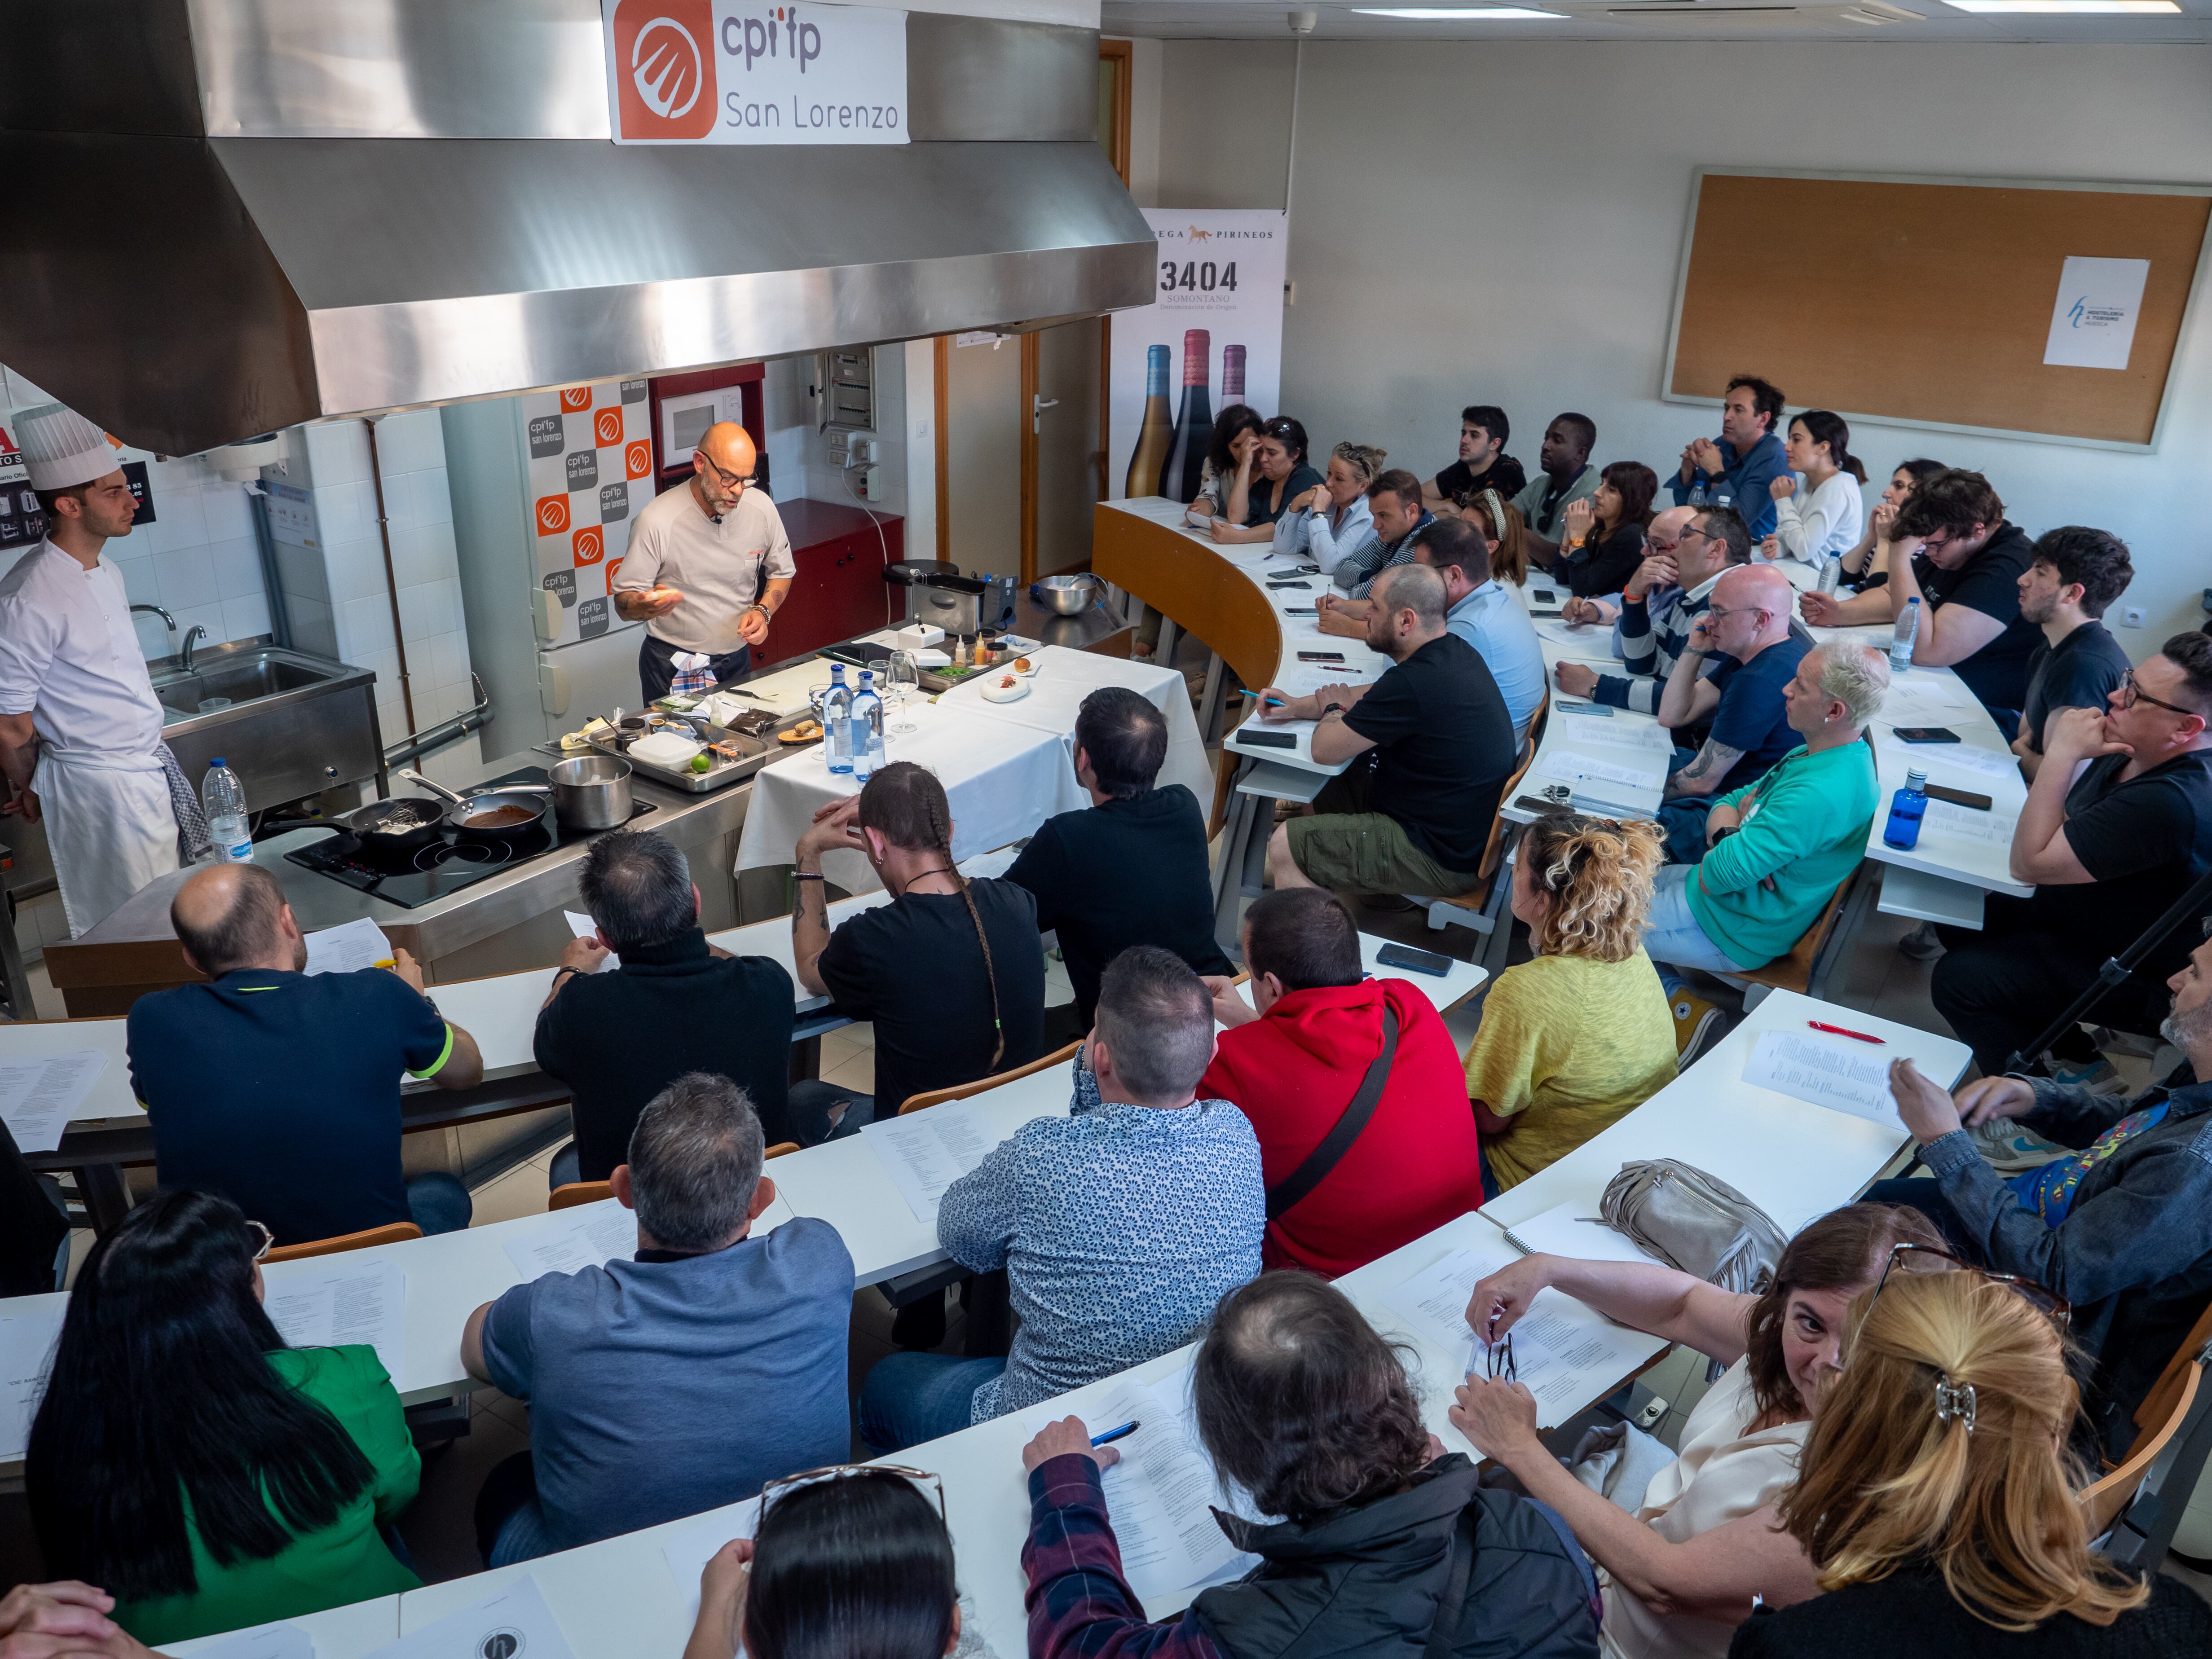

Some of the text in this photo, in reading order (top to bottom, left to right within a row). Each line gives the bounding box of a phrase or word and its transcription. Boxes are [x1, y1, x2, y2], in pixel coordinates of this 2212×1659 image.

[726, 92, 898, 128] San Lorenzo
[1160, 261, 1237, 291] 3404
[1168, 295, 1230, 303] SOMONTANO
[532, 432, 562, 444] san lorenzo
[568, 466, 596, 478] san lorenzo
[602, 497, 627, 510] san lorenzo
[556, 585, 574, 597] lorenzo
[581, 612, 607, 626] san lorenzo
